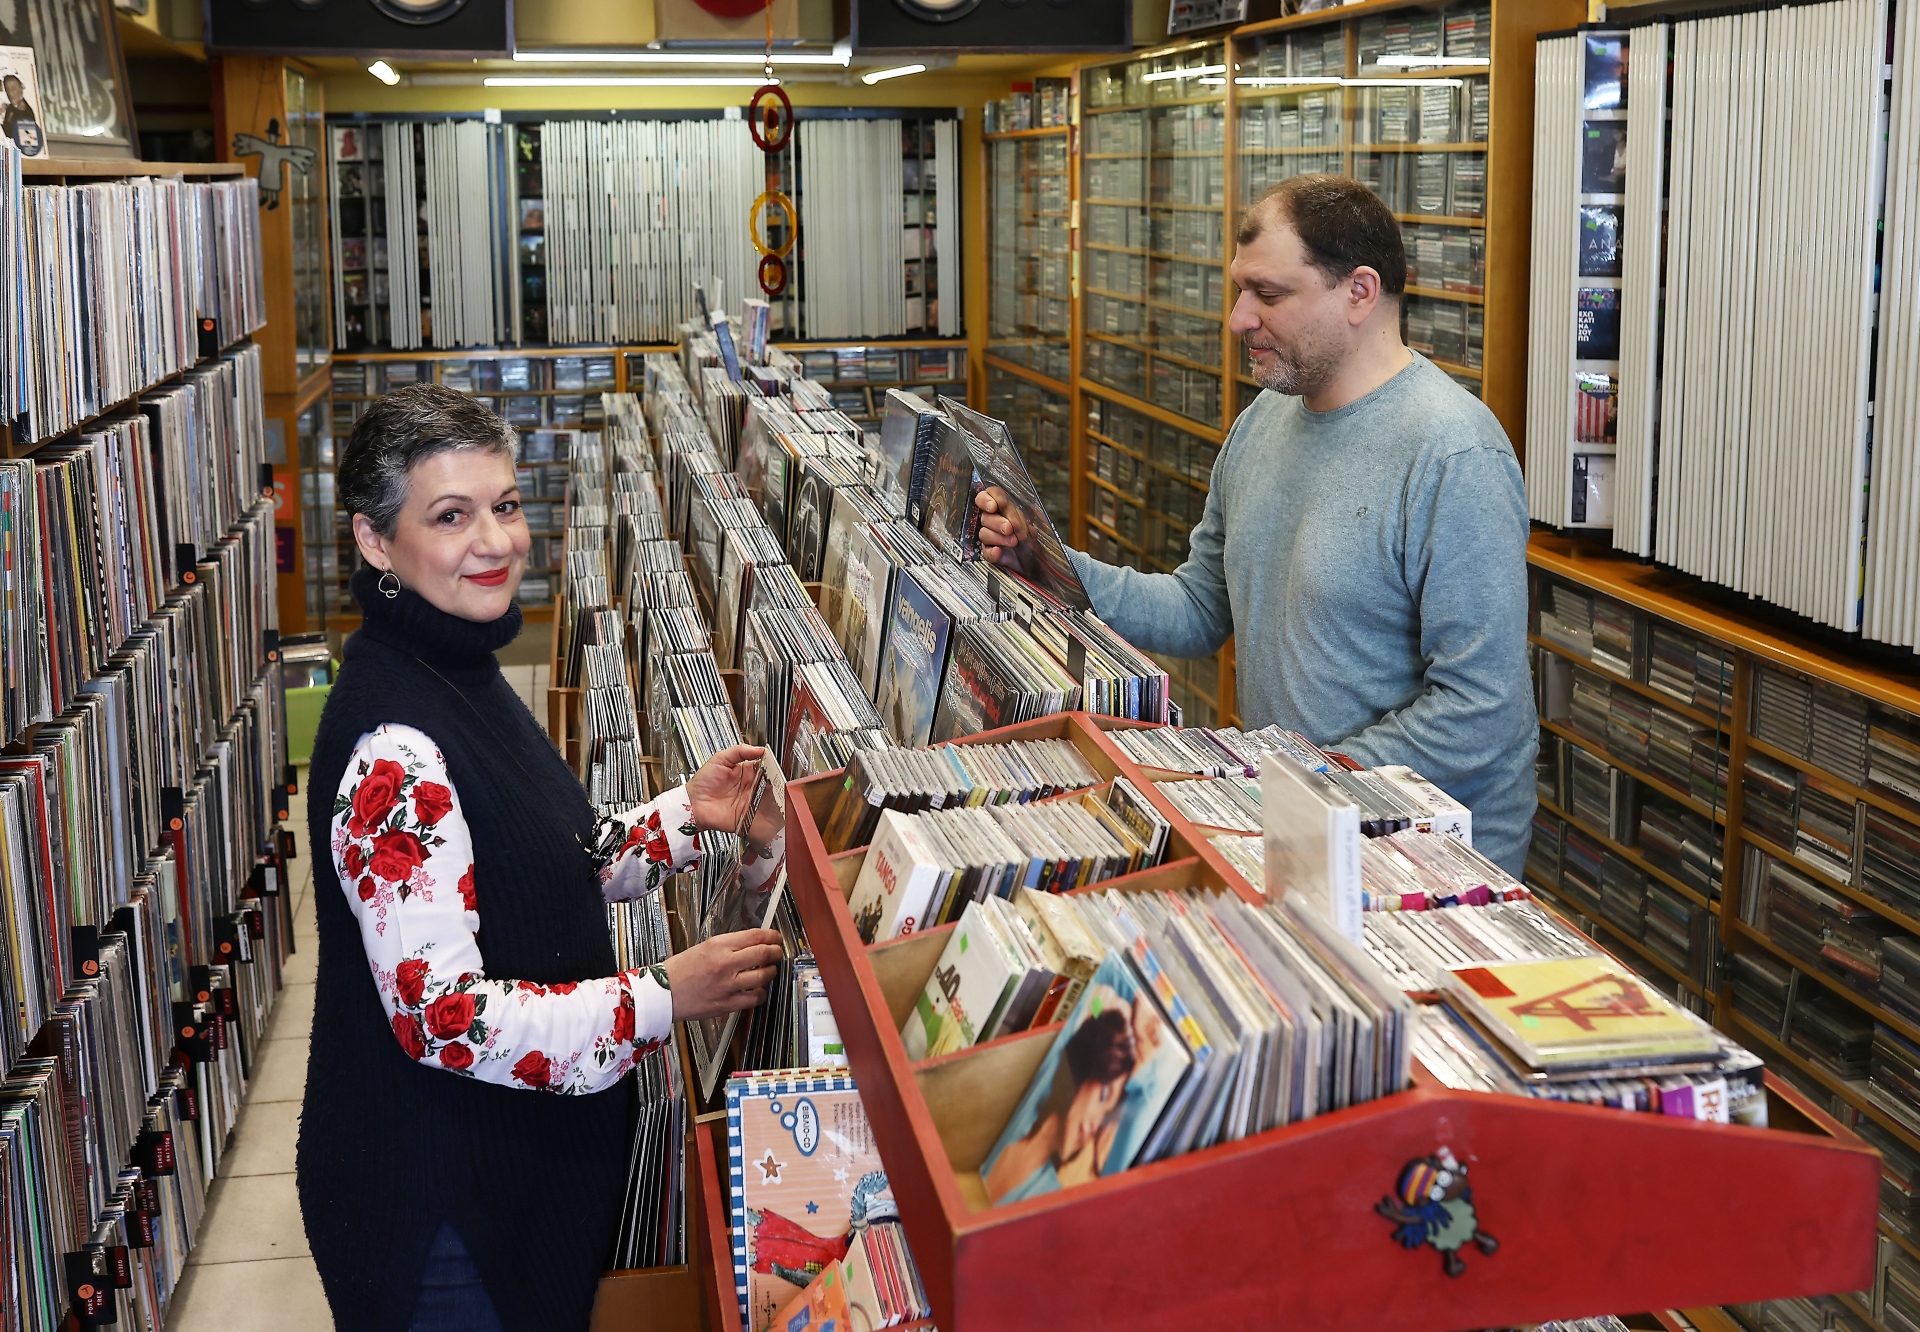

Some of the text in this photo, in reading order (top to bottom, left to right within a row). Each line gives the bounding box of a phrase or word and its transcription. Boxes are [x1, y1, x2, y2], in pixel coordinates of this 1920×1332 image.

[897, 593, 938, 655] vangelis
[874, 850, 898, 896] TANGO
[900, 916, 916, 936] GO
[156, 1147, 164, 1169] STONES
[164, 1137, 172, 1163] ROLLING
